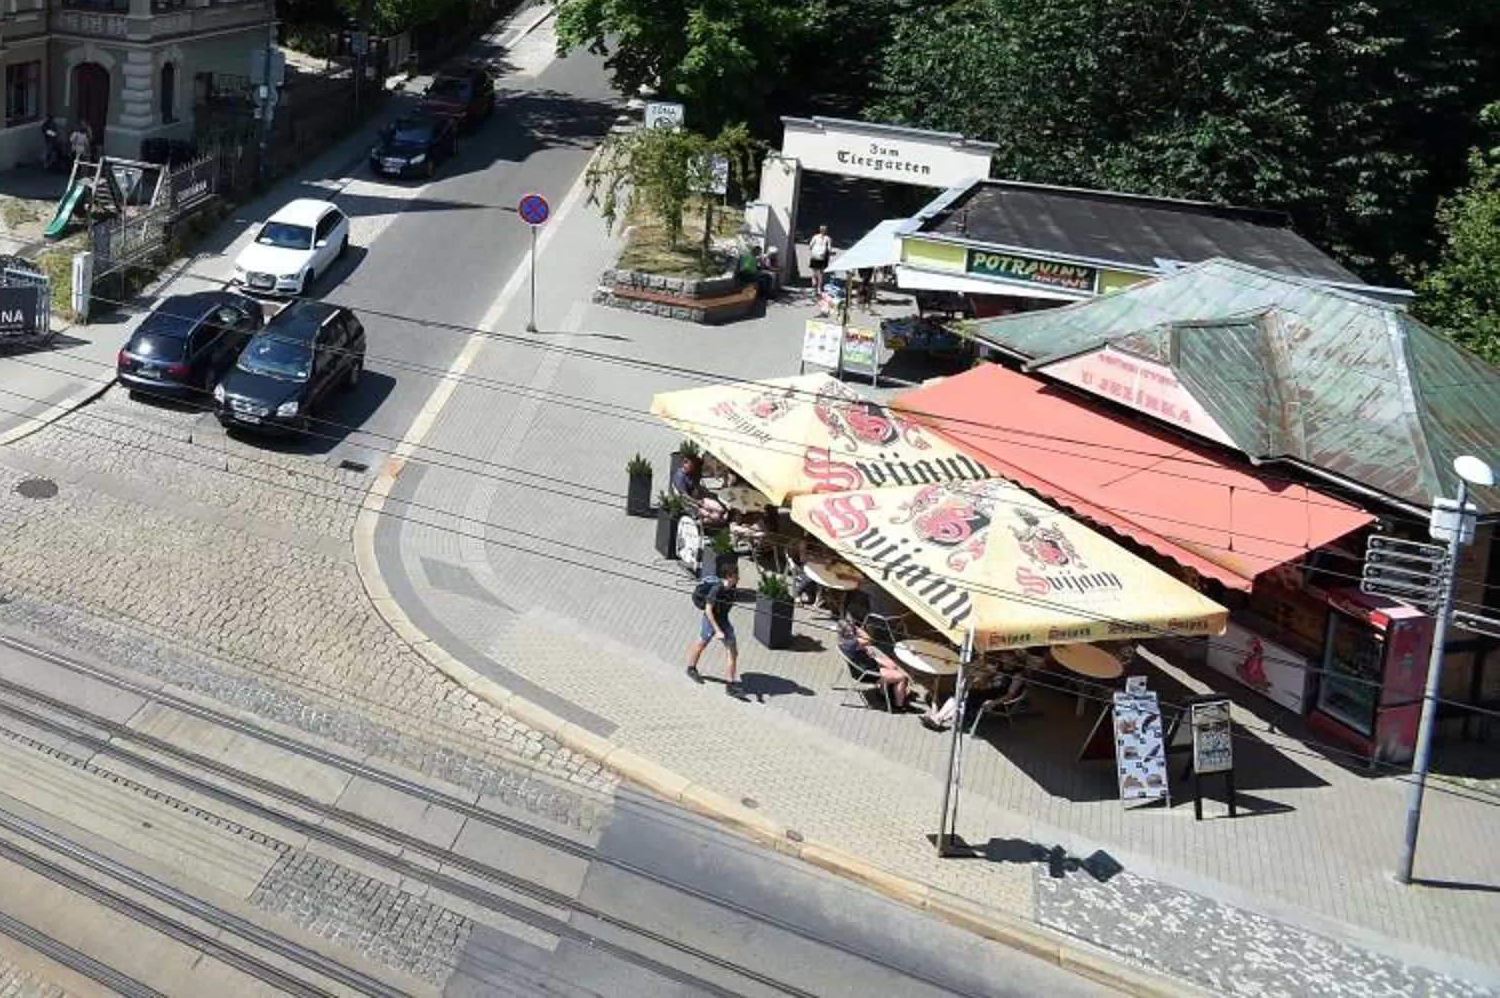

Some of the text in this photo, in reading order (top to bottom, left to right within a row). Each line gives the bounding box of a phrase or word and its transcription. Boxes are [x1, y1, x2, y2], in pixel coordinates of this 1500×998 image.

[837, 150, 931, 174] Tiergarten
[869, 144, 899, 157] Zum
[973, 252, 1088, 277] POTRAVINY
[1015, 565, 1124, 596] Svijany
